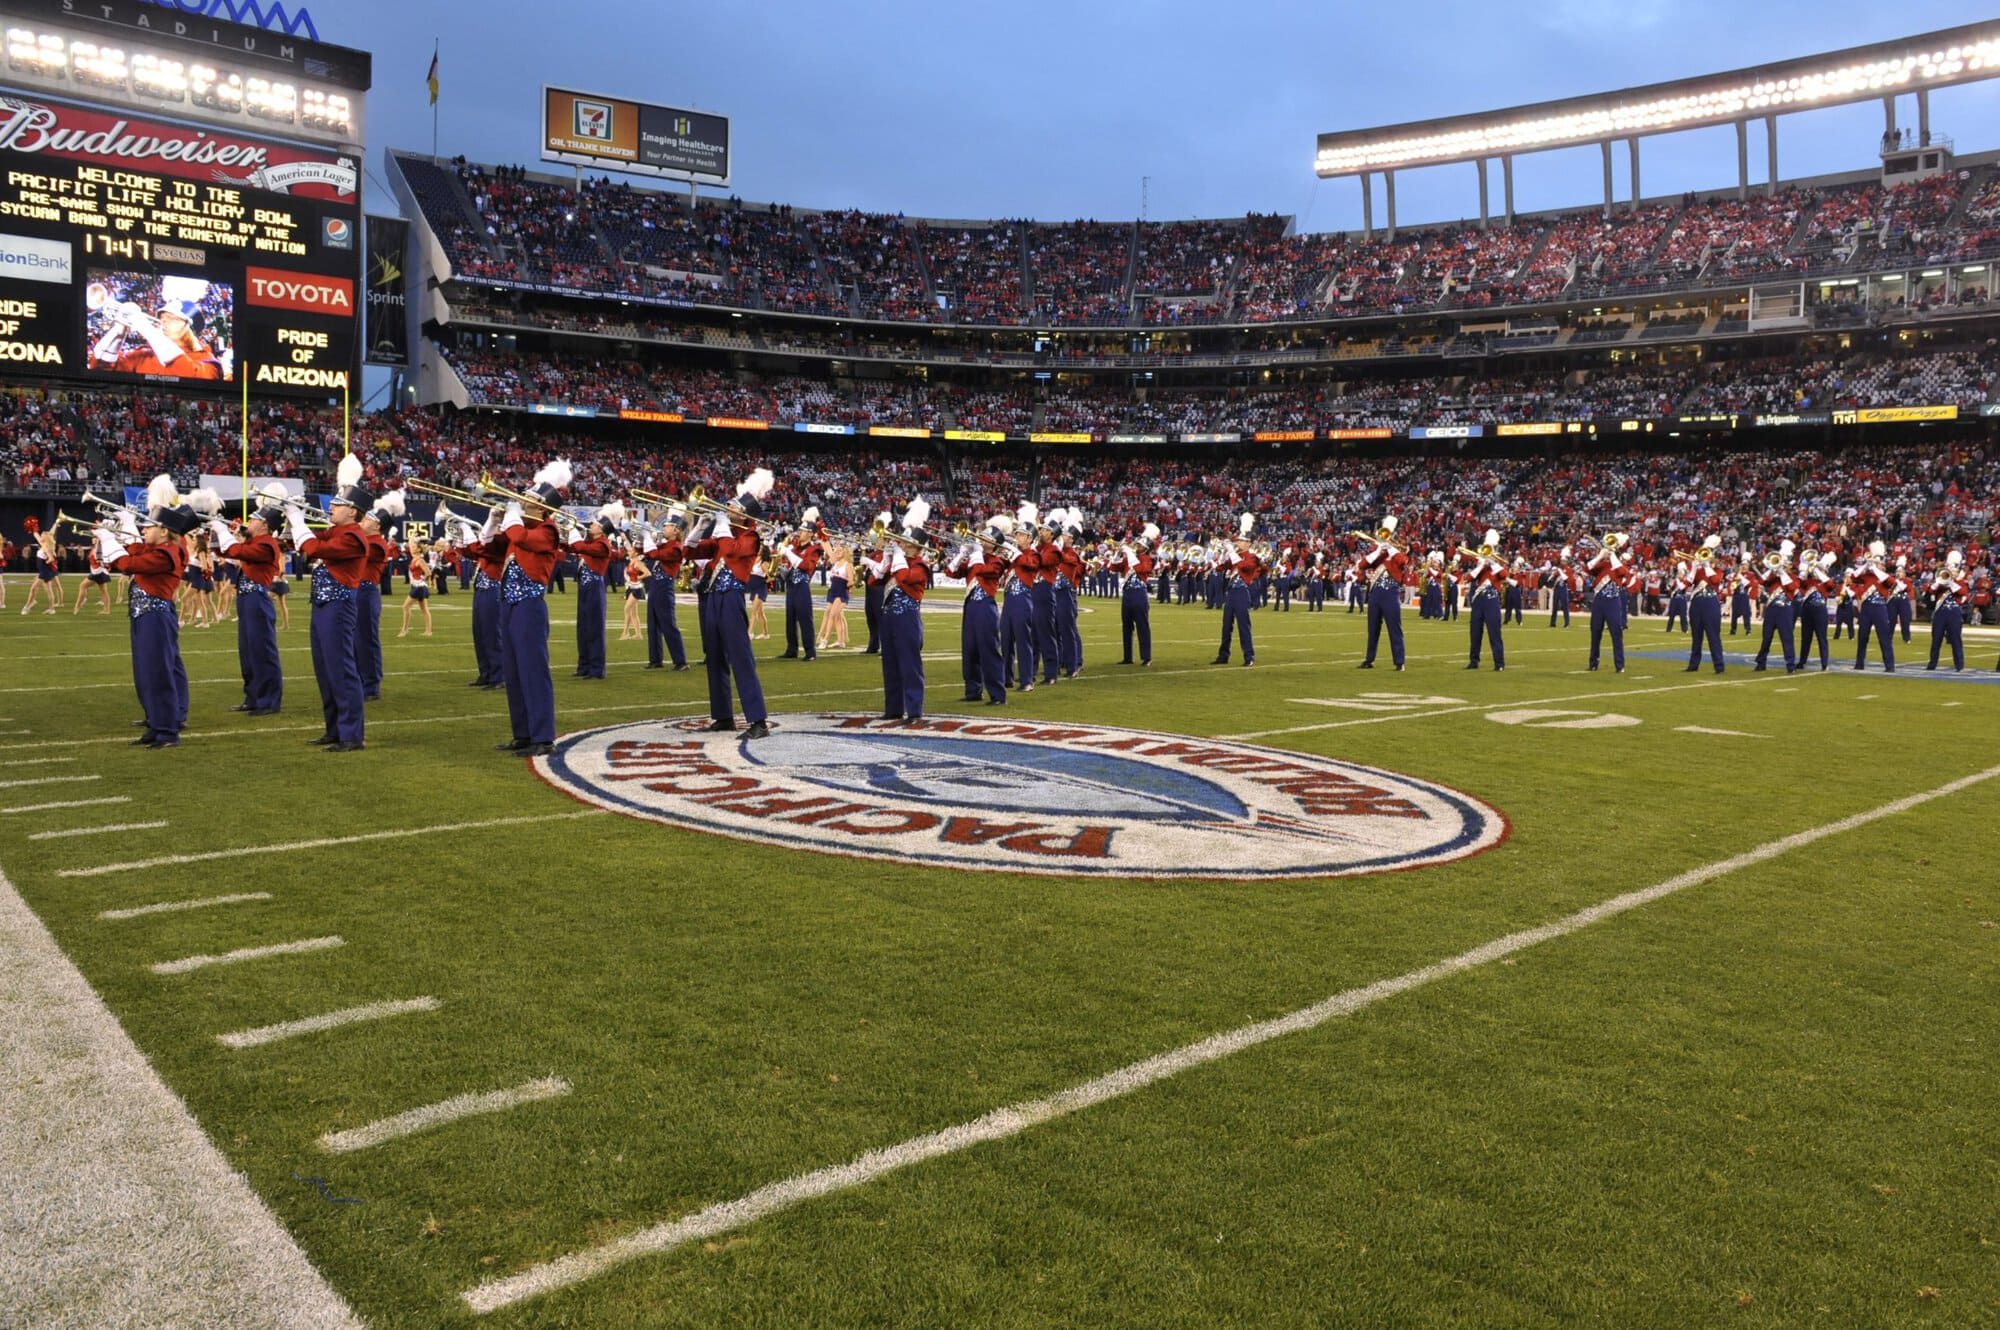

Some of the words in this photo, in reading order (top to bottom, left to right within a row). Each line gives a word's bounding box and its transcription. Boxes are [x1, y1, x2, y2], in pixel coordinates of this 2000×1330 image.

[63, 0, 295, 58] STADIUM
[0, 104, 267, 168] Budweiser
[566, 140, 598, 151] THANK
[641, 131, 678, 147] Imaging
[678, 137, 725, 153] Healthcare
[662, 153, 686, 163] Partner
[695, 158, 717, 167] Health
[77, 165, 162, 192] WELCOME
[172, 181, 197, 197] TO
[205, 186, 241, 205] THE
[270, 168, 320, 185] American
[322, 168, 353, 185] Lager
[8, 170, 97, 198] PACIFIC
[107, 186, 156, 206] LIFE
[165, 195, 246, 219] HOLIDAY
[254, 208, 298, 228] BOWL
[19, 190, 98, 213] PRE-GAME
[106, 203, 145, 219] SHOW
[151, 209, 232, 231] PRESENTED
[238, 222, 257, 235] BY
[264, 226, 290, 240] THE
[0, 200, 60, 221] SYCUAN
[68, 211, 108, 228] BAND
[115, 217, 135, 231] OF
[143, 221, 171, 236] THE
[178, 226, 249, 248] KUMEYAAY
[255, 237, 306, 256] NATION
[85, 232, 151, 260] 17:47
[155, 246, 205, 263] SYCUAN
[252, 278, 349, 307] TOYOTA
[367, 289, 405, 306] Sprint
[278, 328, 328, 347] PRIDE
[291, 349, 315, 364] OF
[256, 364, 349, 389] ARIZONA
[622, 410, 651, 420] WELLS
[652, 412, 682, 422] FARGO
[1255, 431, 1284, 440] WELLS
[1286, 430, 1315, 440] FARGO
[1425, 426, 1470, 438] GEICO
[407, 522, 428, 540] 25
[600, 740, 731, 783] LIFE
[1068, 737, 1431, 820] HOLIDAY
[640, 775, 1119, 859] PACIFIC
